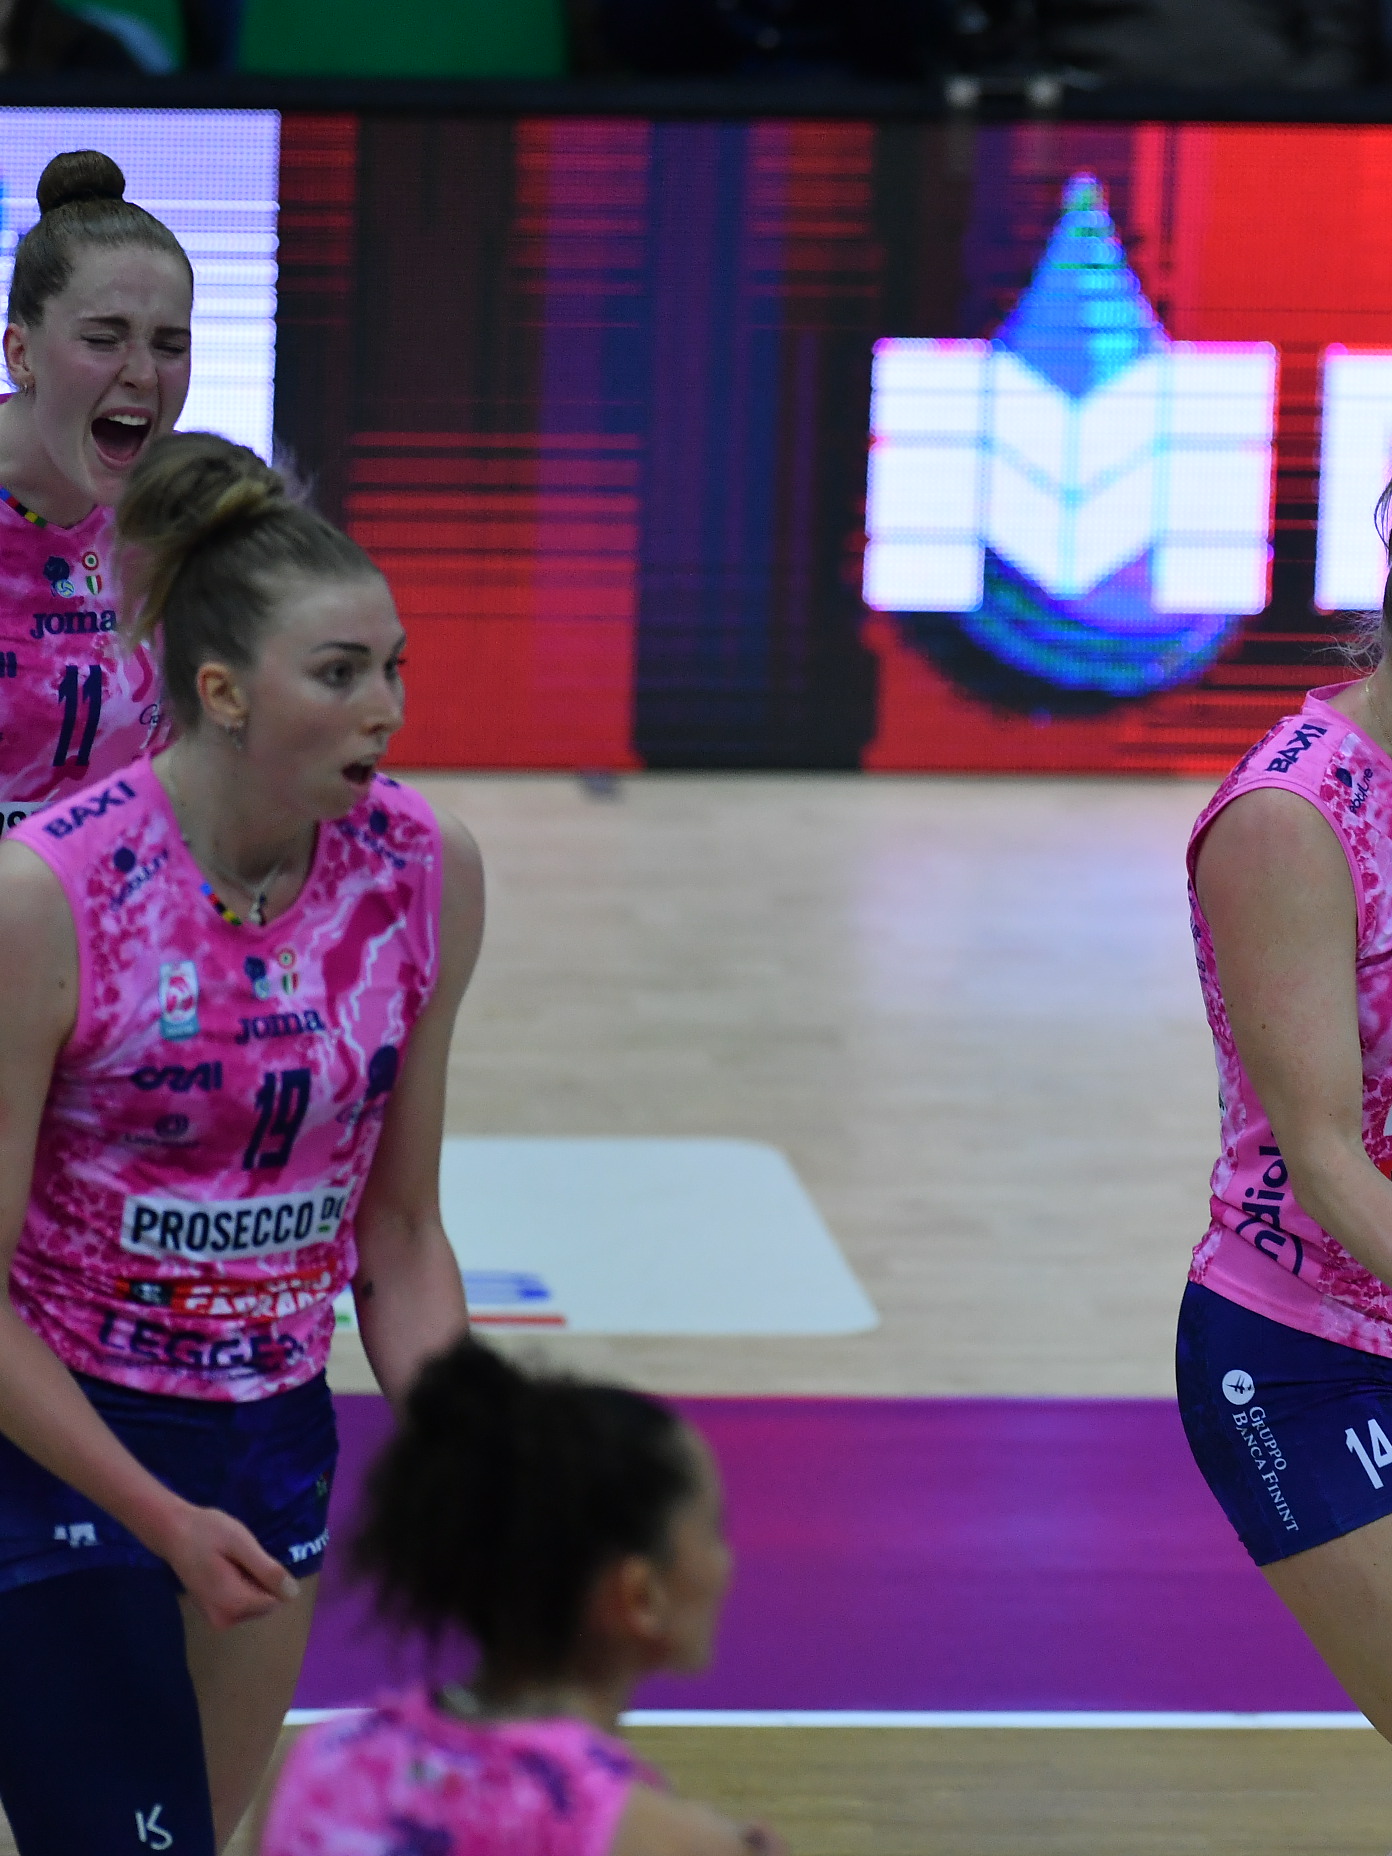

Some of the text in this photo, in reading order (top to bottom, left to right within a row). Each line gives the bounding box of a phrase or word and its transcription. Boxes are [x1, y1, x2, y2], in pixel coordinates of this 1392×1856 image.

[53, 665, 102, 766] 11
[1265, 724, 1327, 773] BAXI
[43, 780, 136, 839] BAXI
[242, 1067, 311, 1171] 19
[133, 1201, 315, 1253] PROSECCO
[1232, 1411, 1299, 1531] BANCA FININT
[1249, 1406, 1287, 1471] GRUPPO
